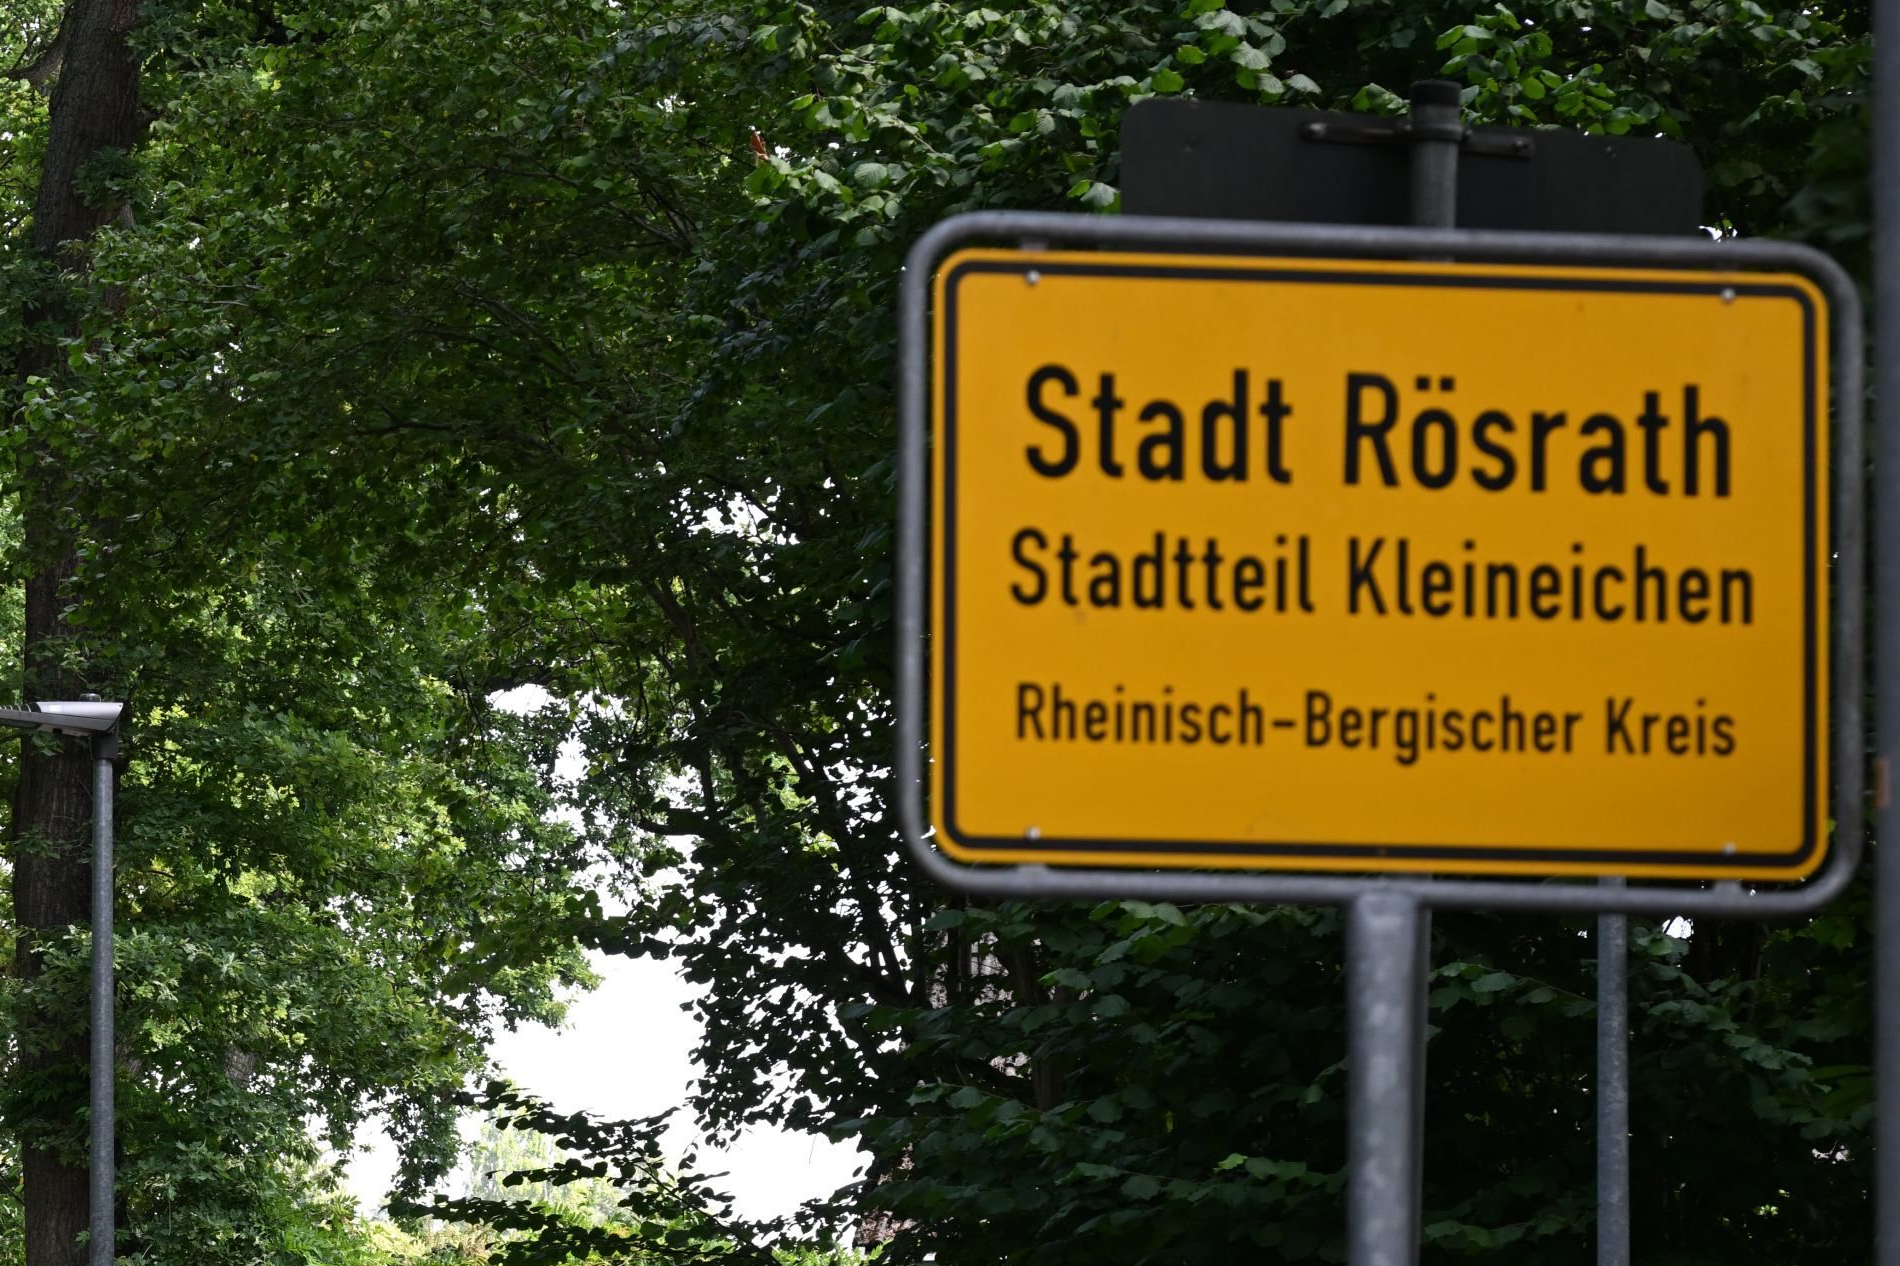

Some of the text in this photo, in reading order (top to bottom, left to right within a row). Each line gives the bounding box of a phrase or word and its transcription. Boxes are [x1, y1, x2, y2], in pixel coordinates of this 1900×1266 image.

[1023, 363, 1734, 498] Stadt Rösrath
[1008, 526, 1756, 627] Stadtteil Kleineichen
[1015, 682, 1737, 766] Rheinisch-Bergischer Kreis
